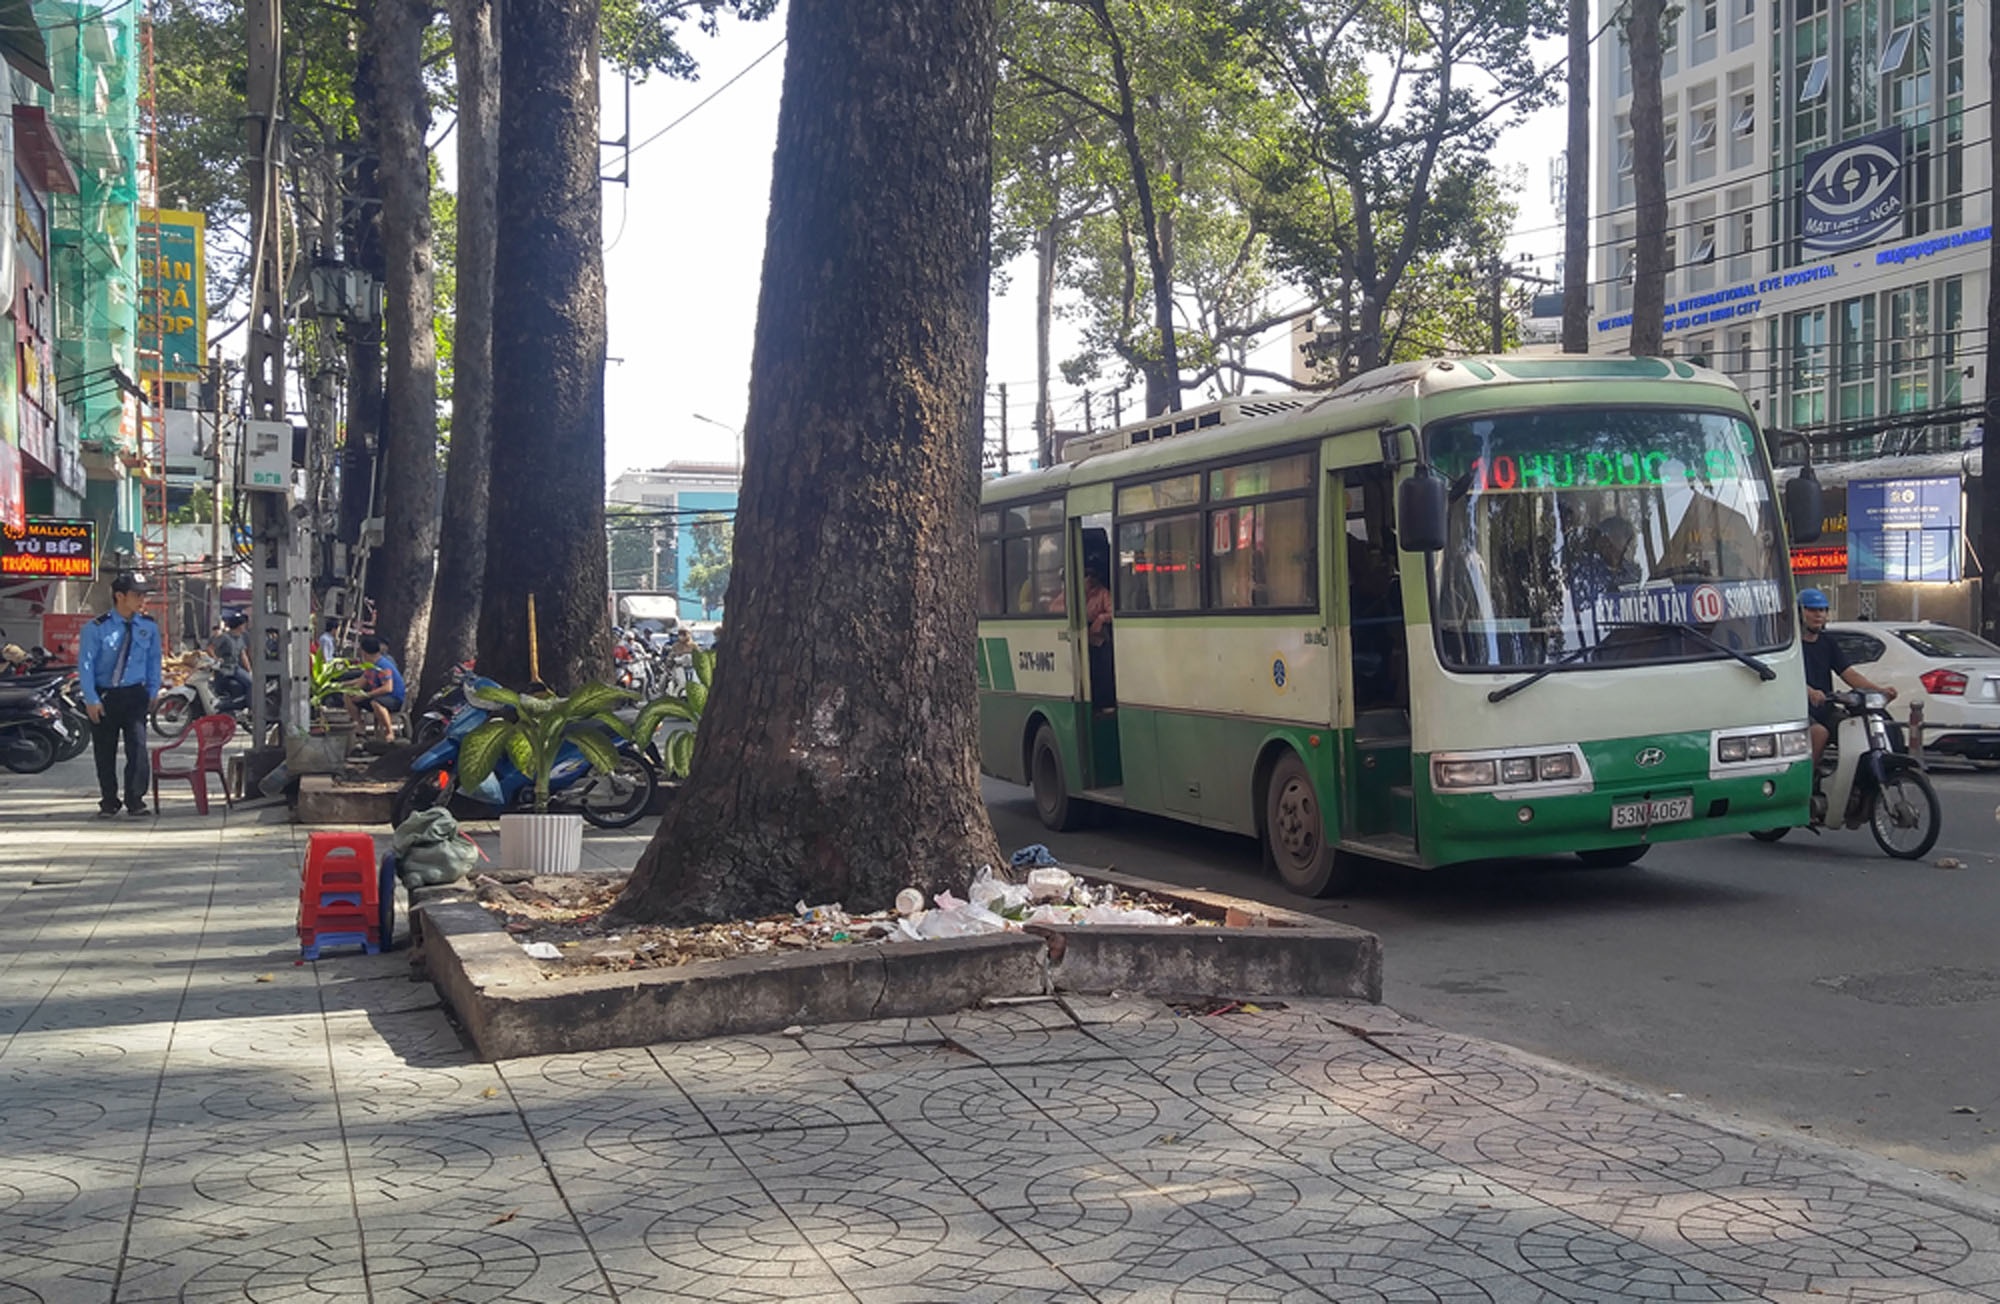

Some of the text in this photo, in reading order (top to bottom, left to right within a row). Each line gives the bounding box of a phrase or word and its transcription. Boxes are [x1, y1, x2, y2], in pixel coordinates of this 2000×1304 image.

[1869, 196, 1900, 221] NGA
[140, 255, 191, 281] BÁN
[142, 282, 190, 308] TRẢ
[1678, 284, 1757, 313] INTERNATIONAL
[1759, 276, 1782, 293] EYE
[1784, 263, 1838, 288] HOSPITAL
[1735, 300, 1762, 317] CITY
[139, 311, 194, 335] GÓP
[1587, 450, 1670, 488] DUC
[28, 525, 87, 537] MALLOCA
[15, 537, 82, 554] TỦ BẾP
[49, 557, 90, 576] THẠNH
[1698, 593, 1719, 617] 10
